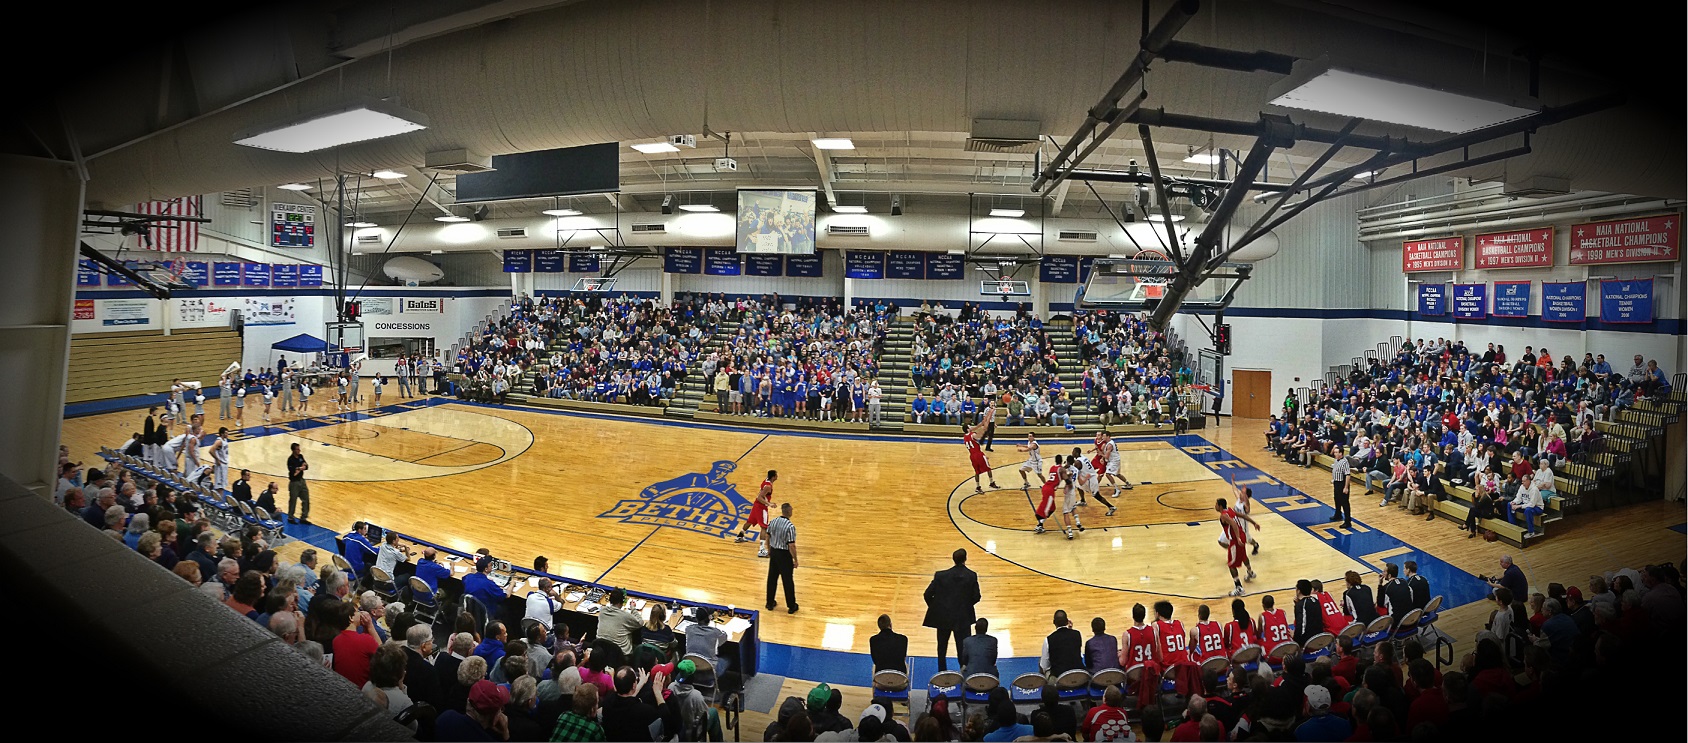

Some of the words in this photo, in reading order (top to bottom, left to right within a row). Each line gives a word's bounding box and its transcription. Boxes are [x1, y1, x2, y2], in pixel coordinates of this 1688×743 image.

[1596, 225, 1612, 236] NAIA
[1615, 221, 1649, 234] NATIONAL
[1428, 242, 1446, 250] NATIONAL
[1494, 235, 1505, 244] NAIA
[1507, 233, 1532, 243] NATIONAL
[1580, 236, 1621, 248] BASKETBALL
[1624, 233, 1667, 246] CHAMPIONS
[1409, 251, 1432, 260] BASKETBALL
[1433, 250, 1456, 258] CHAMPIONS
[1482, 246, 1512, 256] BASKETBALL
[1514, 243, 1544, 254] CHAMPIONS
[1588, 250, 1602, 260] 1998
[1606, 249, 1623, 258] MEN'S
[1626, 248, 1650, 258] DIVISION
[1488, 257, 1498, 265] 1997
[1515, 255, 1533, 263] DIVISION
[1181, 446, 1414, 574] BETHEL
[598, 500, 760, 539] BETHEL
[641, 518, 714, 532] PILOTS
[1324, 601, 1339, 616] 21
[1270, 625, 1288, 642] 32
[1166, 634, 1184, 652] 50
[1204, 634, 1222, 652] 22
[1134, 644, 1152, 662] 34
